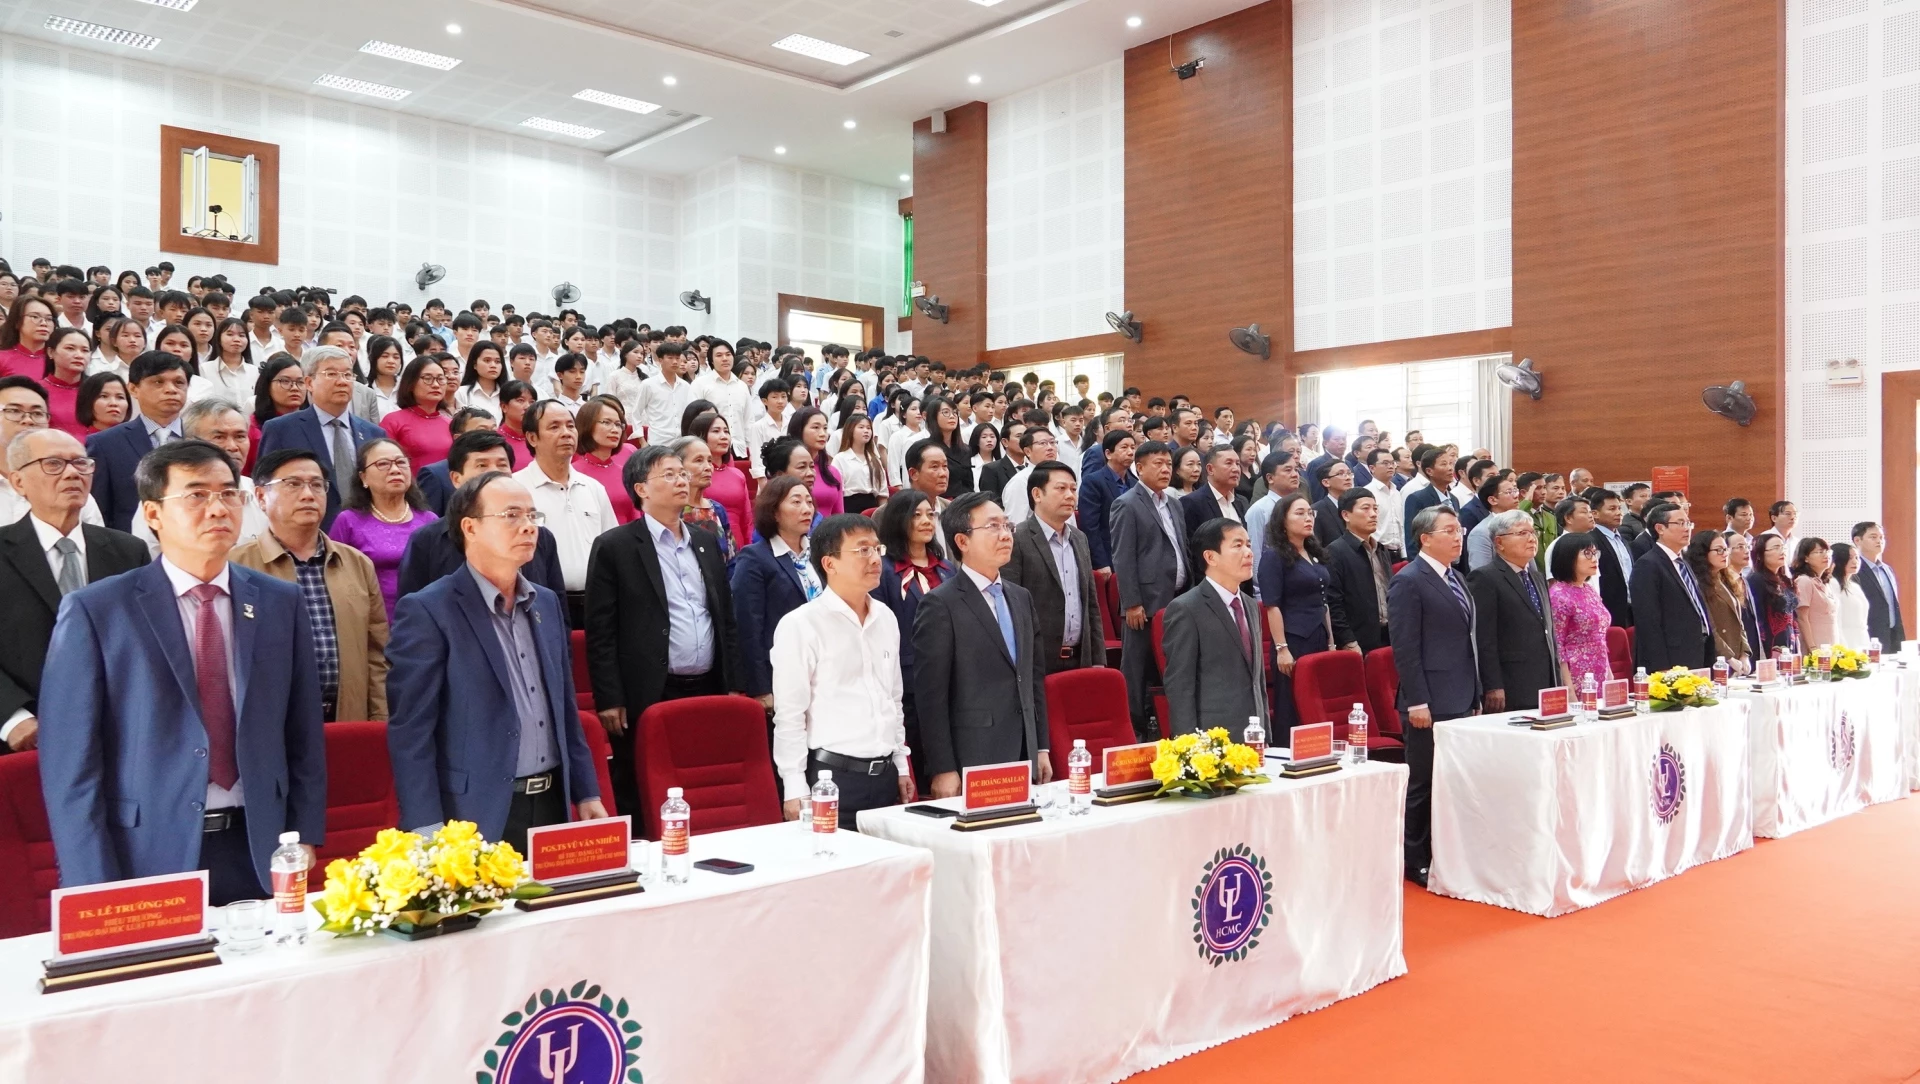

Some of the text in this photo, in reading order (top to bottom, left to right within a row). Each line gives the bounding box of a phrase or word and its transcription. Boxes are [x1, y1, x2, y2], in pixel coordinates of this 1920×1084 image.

[579, 839, 594, 847] VĂN
[97, 905, 112, 916] LÊ
[1215, 923, 1242, 938] HCMC
